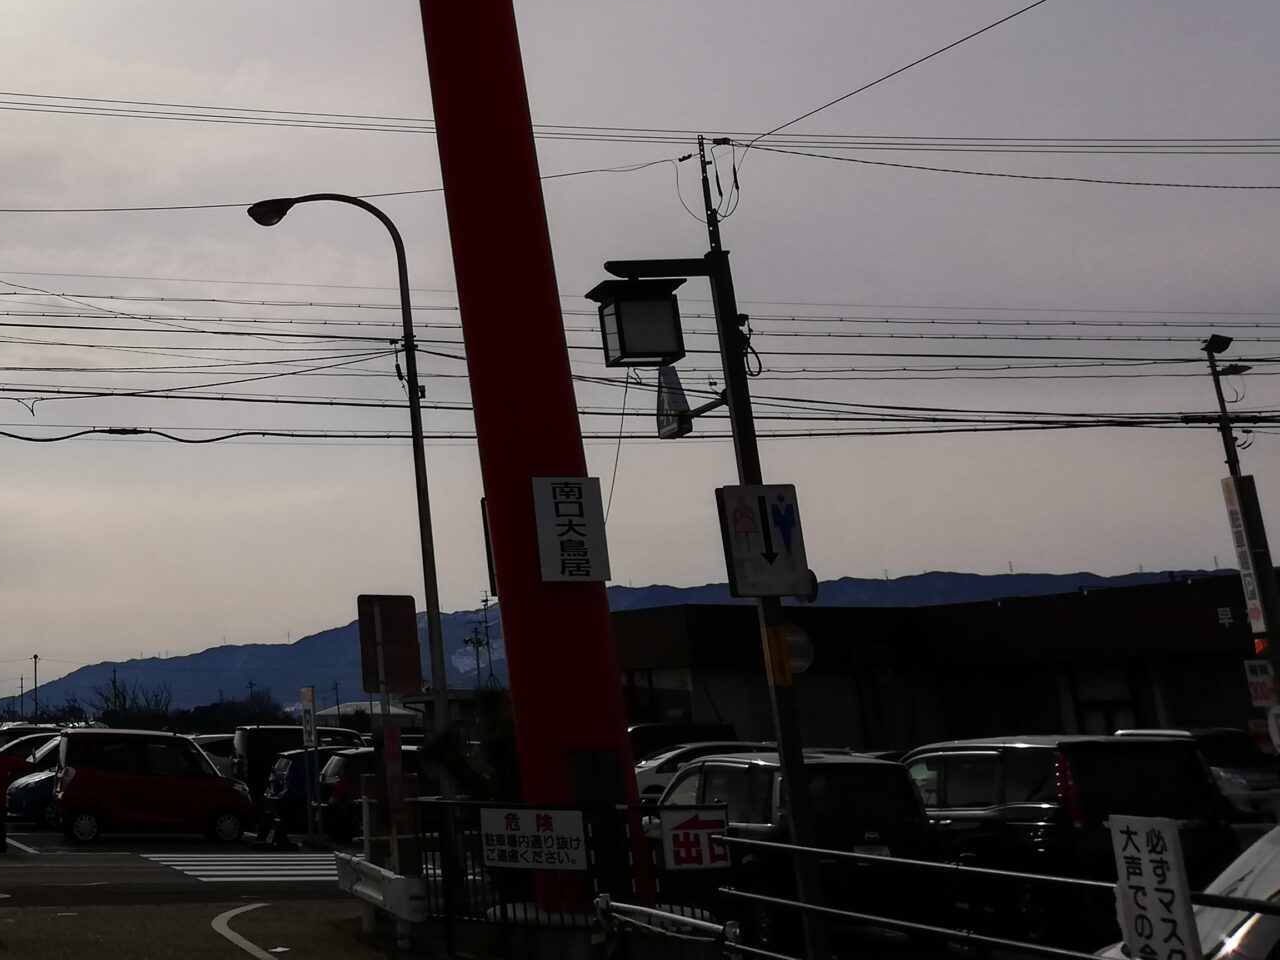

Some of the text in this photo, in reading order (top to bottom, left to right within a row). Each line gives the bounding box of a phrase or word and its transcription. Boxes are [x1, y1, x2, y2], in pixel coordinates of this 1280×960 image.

[551, 482, 591, 577] 南口大鳥居
[504, 813, 553, 832] 危険
[485, 833, 581, 850] 駐車場内通り抜け
[672, 832, 728, 865] 出口
